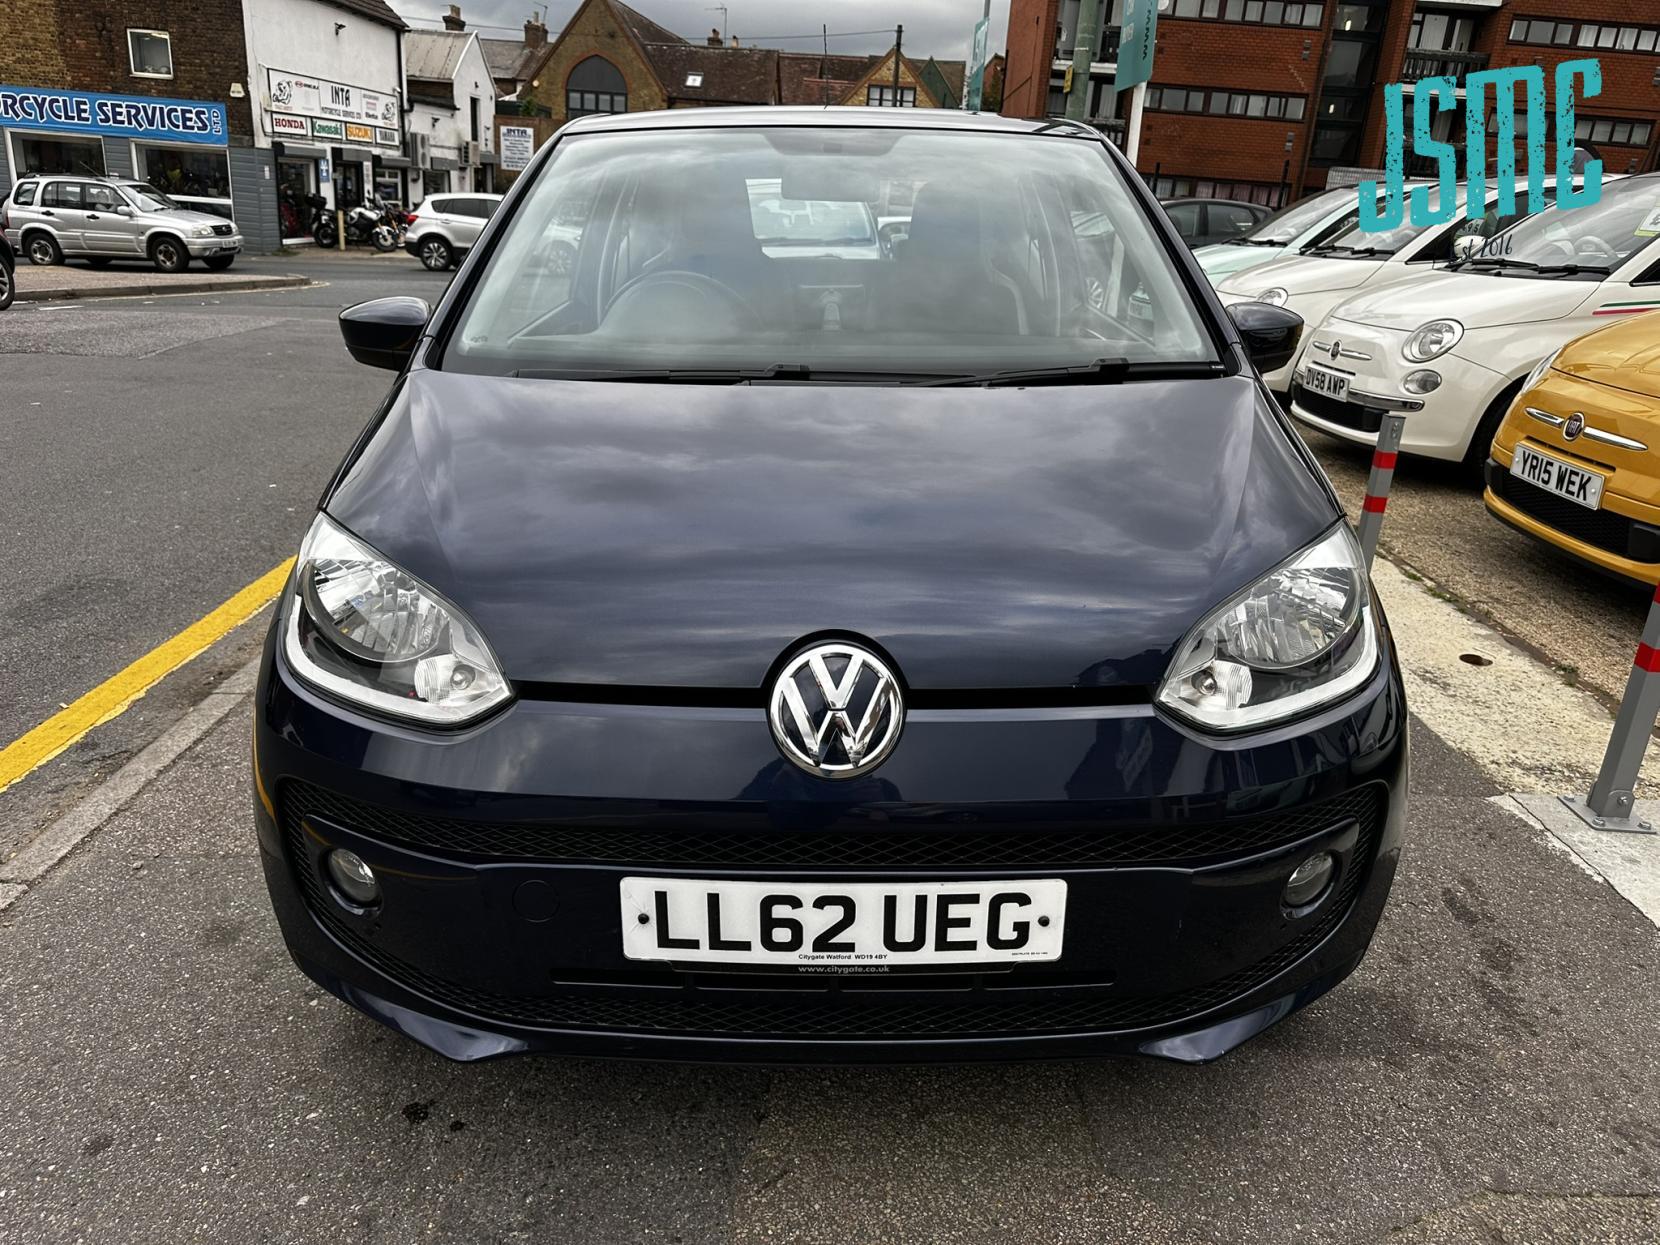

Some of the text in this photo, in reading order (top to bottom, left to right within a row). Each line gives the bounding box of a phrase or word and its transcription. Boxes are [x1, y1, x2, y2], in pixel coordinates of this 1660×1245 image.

[331, 85, 351, 107] INTA
[96, 101, 209, 133] SERVICES
[212, 110, 222, 135] LTD
[274, 118, 305, 130] HONDA
[313, 120, 342, 136] Kawasaki
[347, 123, 372, 139] SUZUKI
[1306, 368, 1345, 396] DY58 AWP
[1519, 449, 1592, 502] YR15 WEK
[654, 890, 1033, 953] LL62 UEG
[798, 953, 824, 961] Citygate
[798, 965, 890, 974] www.citygate.co.uk
